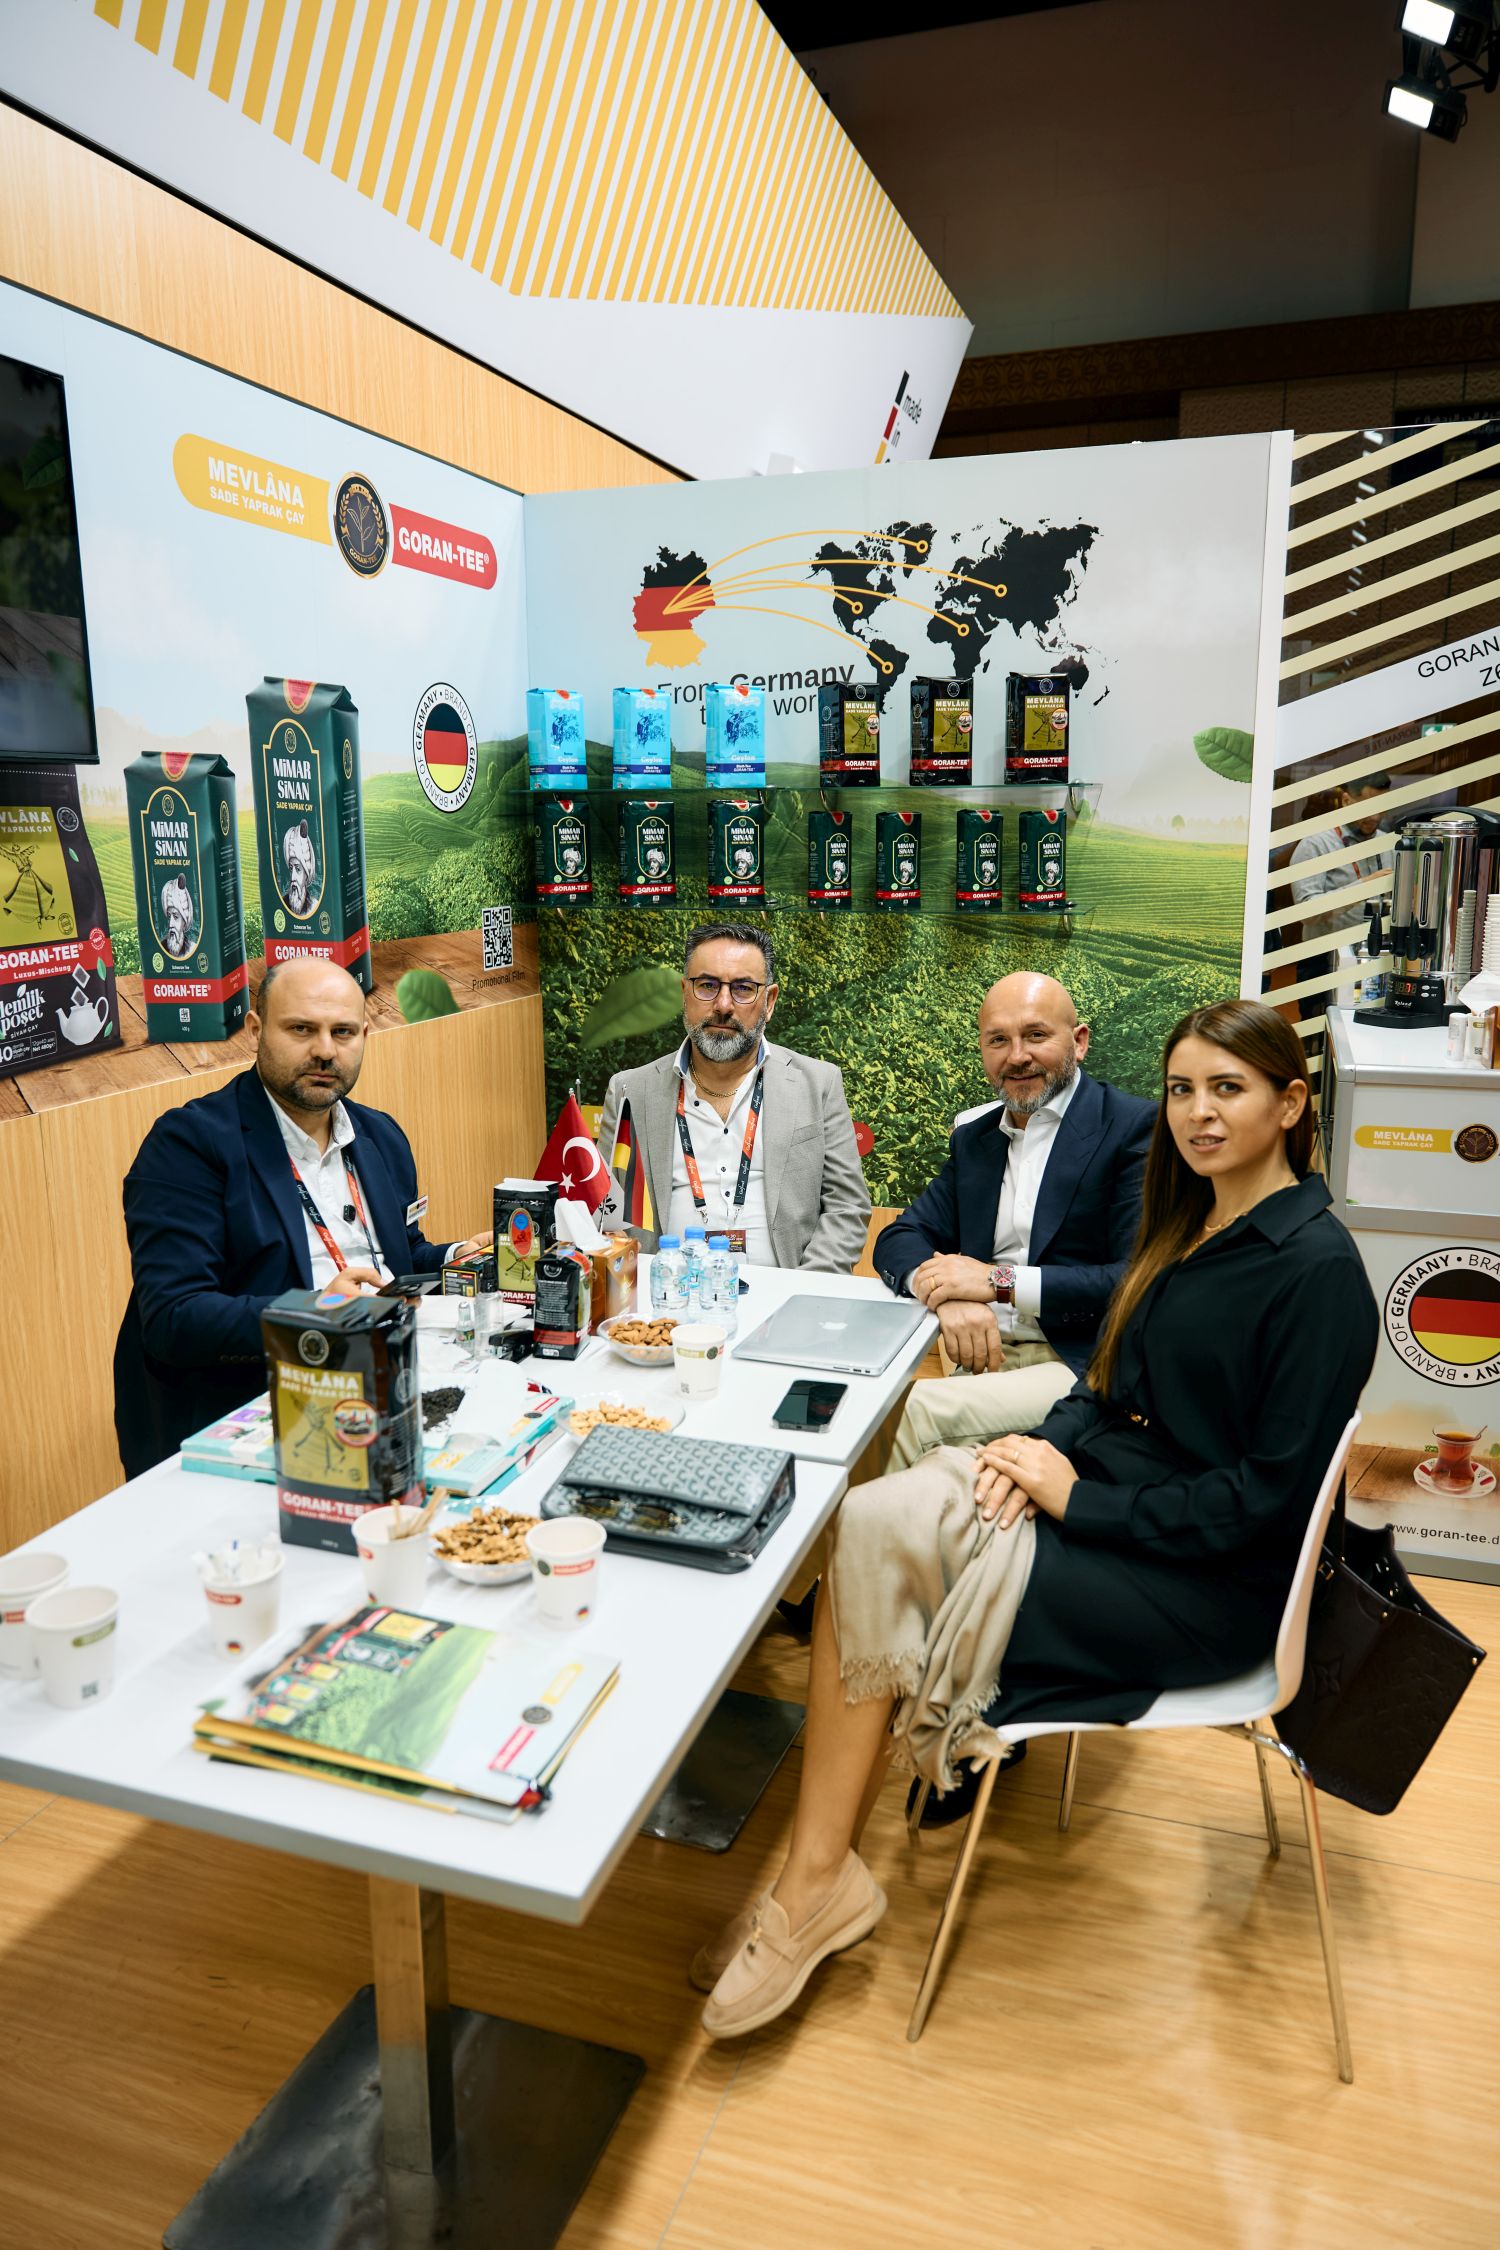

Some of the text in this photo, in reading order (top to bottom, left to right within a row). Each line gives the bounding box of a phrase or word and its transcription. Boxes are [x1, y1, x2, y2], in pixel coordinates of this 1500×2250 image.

[903, 395, 922, 424] made
[208, 456, 304, 508] MEVLÂNA
[210, 486, 305, 525] SADE YAPRAK ÇAY
[416, 690, 437, 750] GERMANY
[444, 689, 468, 720] BRAND
[455, 746, 476, 806] GERMANY
[13, 965, 71, 979] Luxus-Mischung
[1, 1005, 44, 1036] poşet
[1373, 1130, 1434, 1142] MEVLÂNA
[1468, 1254, 1500, 1276] BRA
[1391, 1254, 1450, 1317] GERMANY
[1391, 1322, 1408, 1342] OF
[280, 1365, 358, 1390] MEVLÂNA
[1404, 1345, 1457, 1381] BRAND
